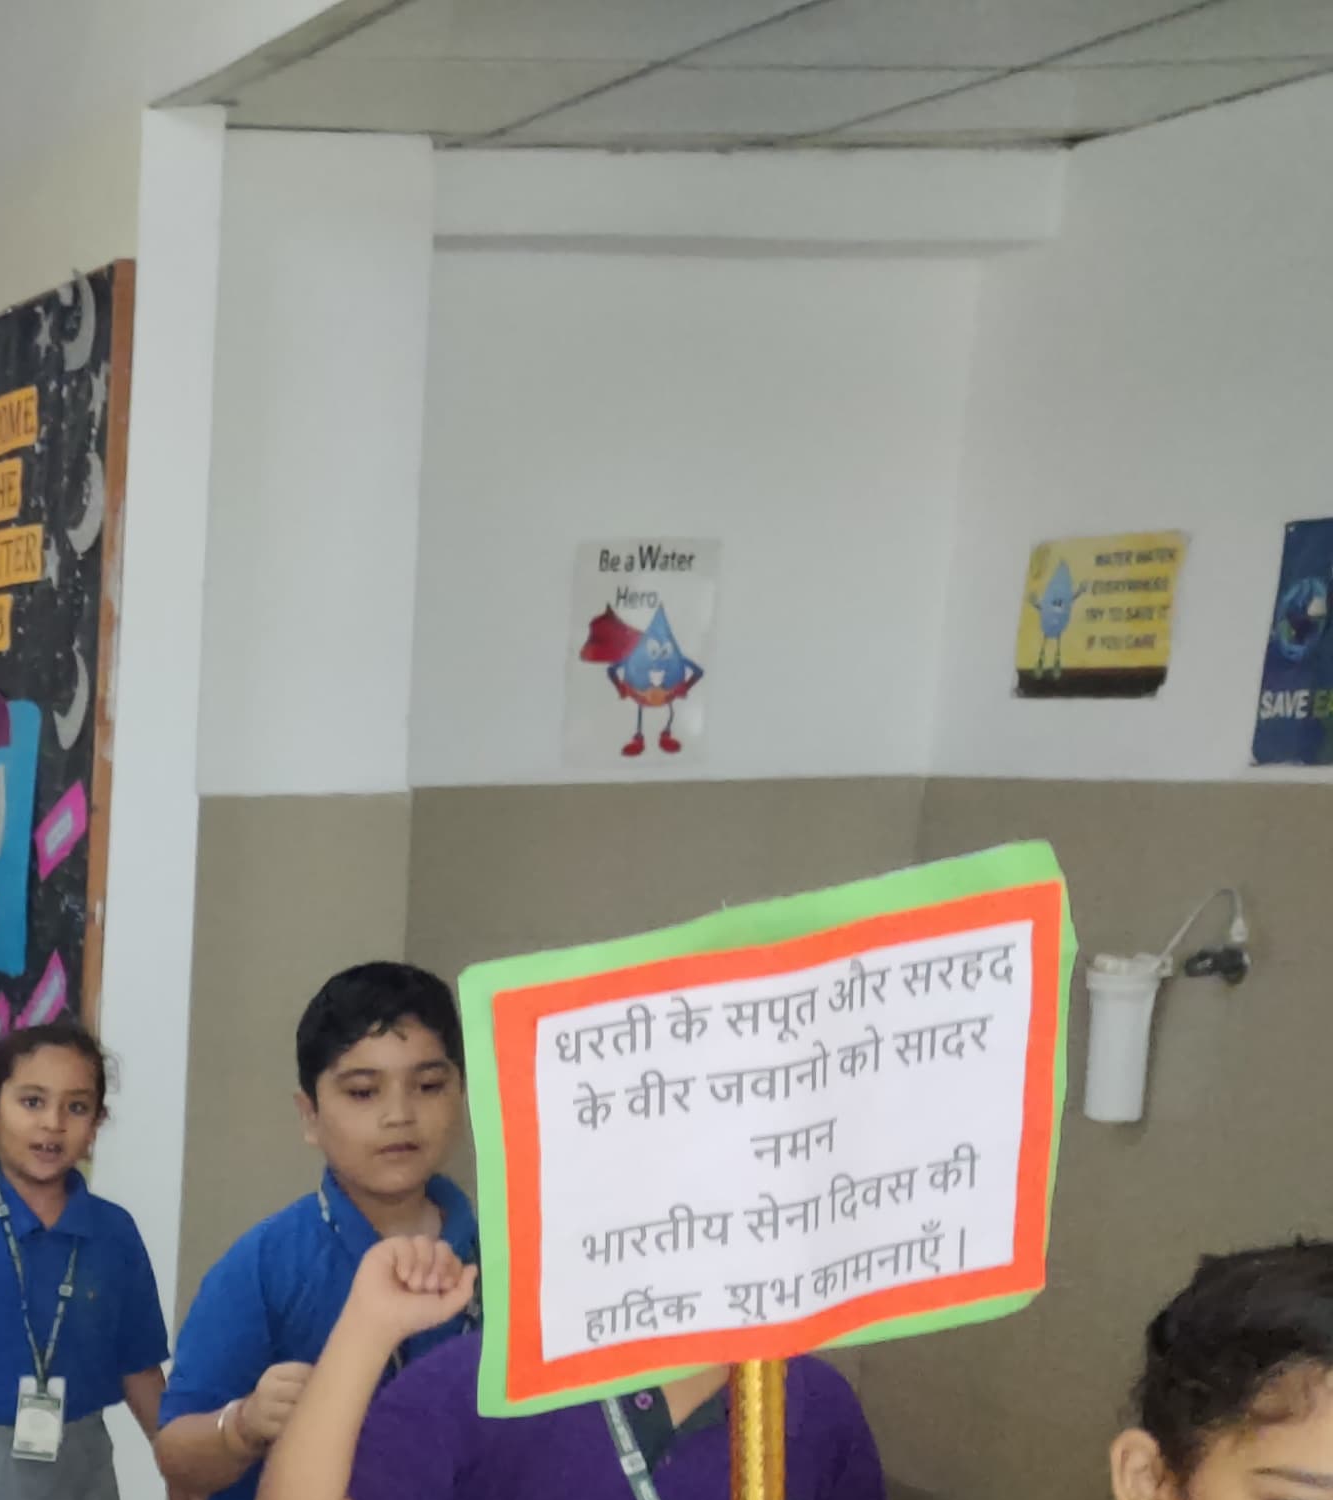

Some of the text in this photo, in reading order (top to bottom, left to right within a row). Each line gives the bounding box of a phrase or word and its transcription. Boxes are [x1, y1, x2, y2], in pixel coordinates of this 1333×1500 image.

[599, 544, 695, 572] Be a Water
[614, 586, 658, 609] Hero
[1260, 689, 1310, 719] SAVE
[556, 943, 1016, 1065] धरती के सपूत और सरहद
[572, 1014, 995, 1131] के वीर जवानो को सादर
[750, 1117, 837, 1168] नमन
[582, 1142, 981, 1266] भारतीय सेना दिवस की
[584, 1285, 702, 1343] हार्दिक
[724, 1273, 805, 1325] शुभ
